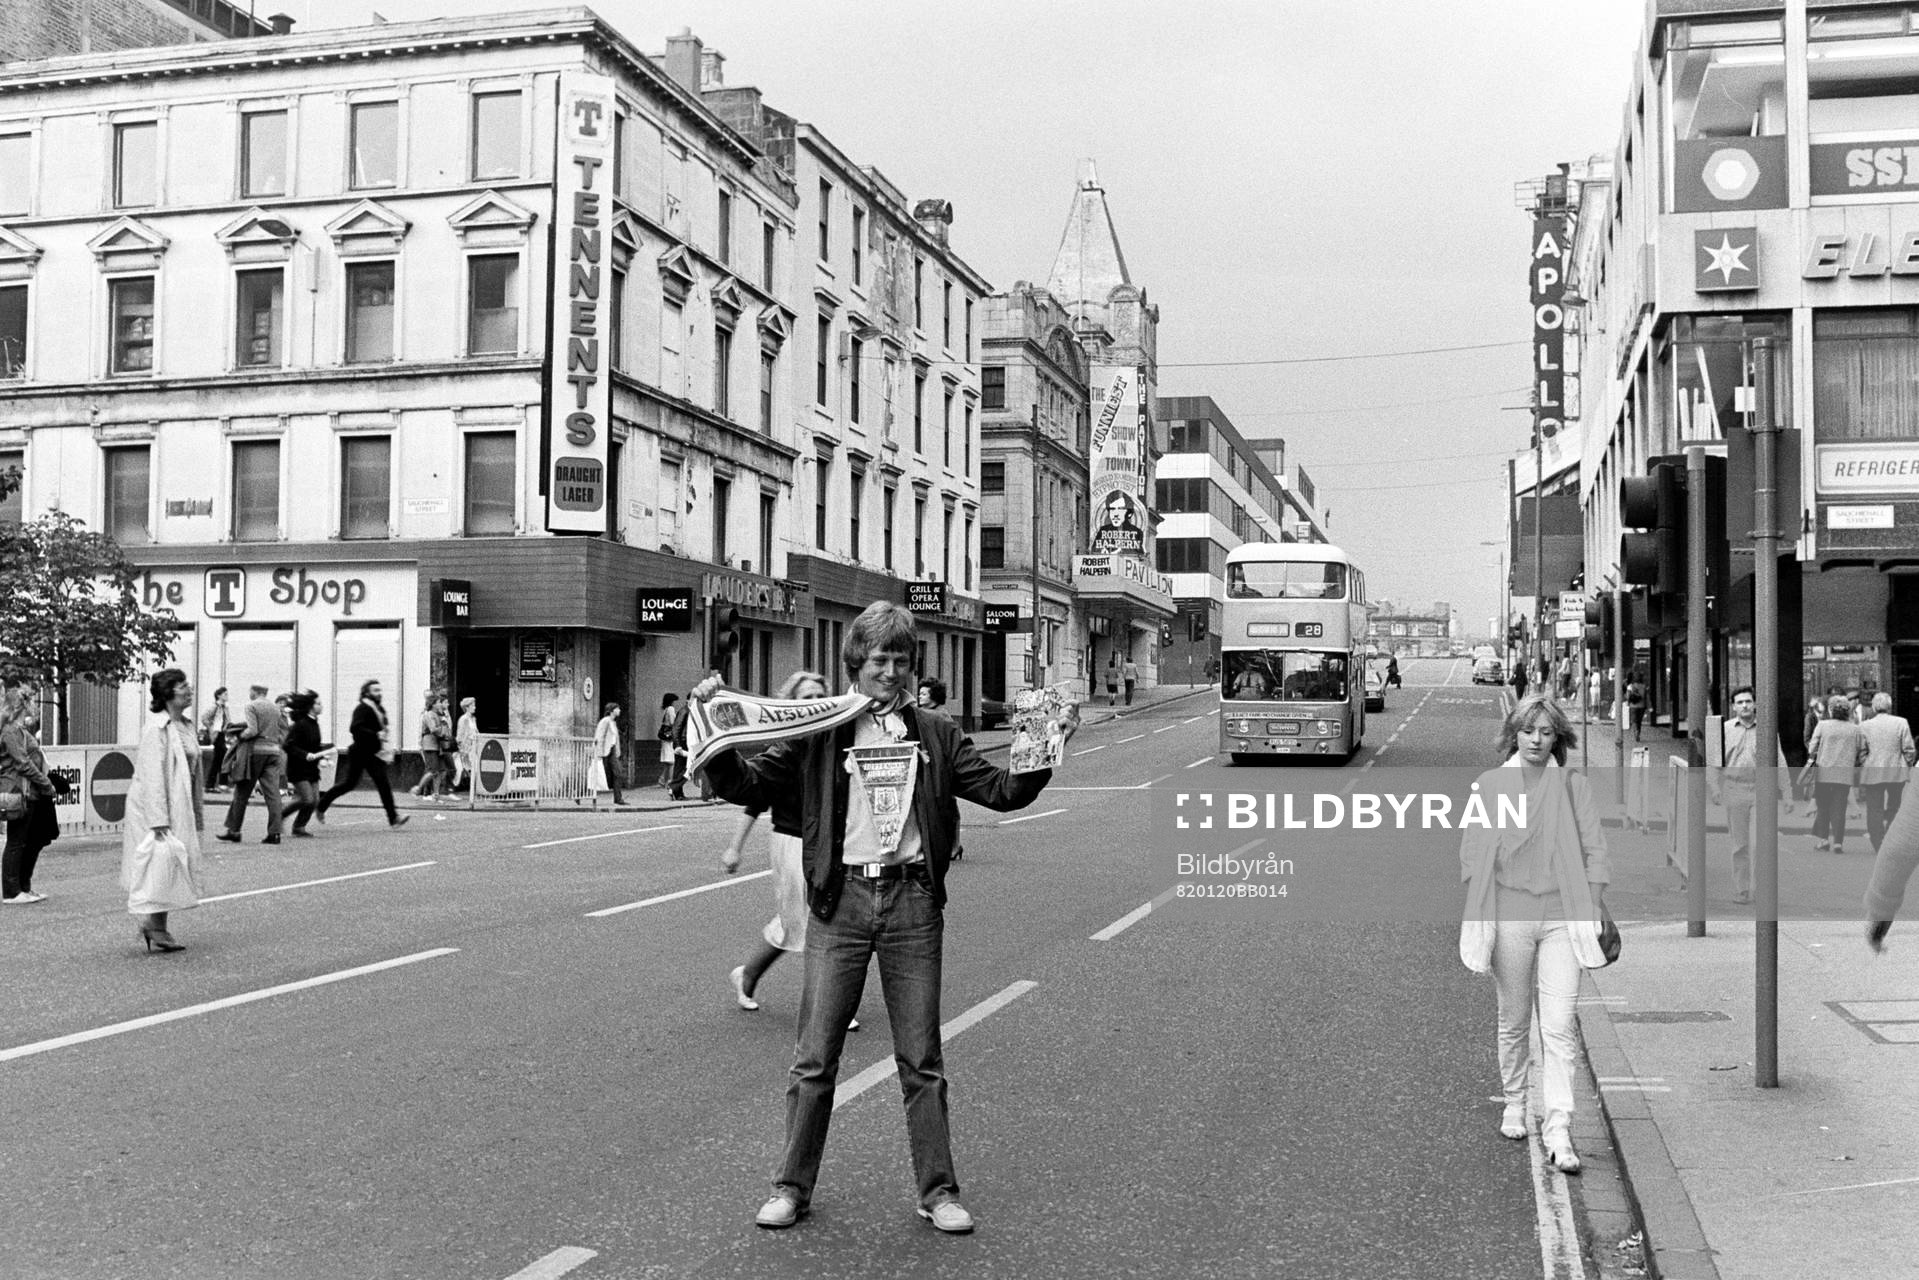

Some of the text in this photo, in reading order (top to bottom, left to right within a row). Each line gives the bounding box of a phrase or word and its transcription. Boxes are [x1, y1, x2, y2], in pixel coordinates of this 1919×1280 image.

[574, 98, 602, 137] T
[566, 154, 603, 447] TENNENTS
[1535, 231, 1563, 442] APOLLO
[1091, 386, 1106, 401] THE
[1092, 375, 1128, 453] FUNNIEST
[1111, 426, 1136, 441] SHOW
[1138, 373, 1146, 496] THE PAVILION
[1117, 442, 1126, 456] IN
[1105, 457, 1136, 471] TOWN!
[556, 466, 601, 484] DRAUGHT
[563, 486, 594, 503] LAGER
[1101, 530, 1137, 540] ROBERT
[1096, 539, 1141, 549] HALPERN
[1082, 557, 1110, 567] ROBERT
[1080, 566, 1111, 576] HALPERN
[142, 569, 184, 608] he
[270, 567, 366, 616] Shop
[909, 585, 931, 593] GRILL
[443, 591, 468, 604] LOUNGE
[911, 594, 939, 602] OPERA
[456, 605, 468, 616] BAR
[642, 599, 688, 610] LOUNGE
[908, 602, 941, 611] LOUNGE
[642, 611, 664, 621] BAR
[986, 610, 1015, 618] SALOON
[1305, 625, 1321, 636] 28
